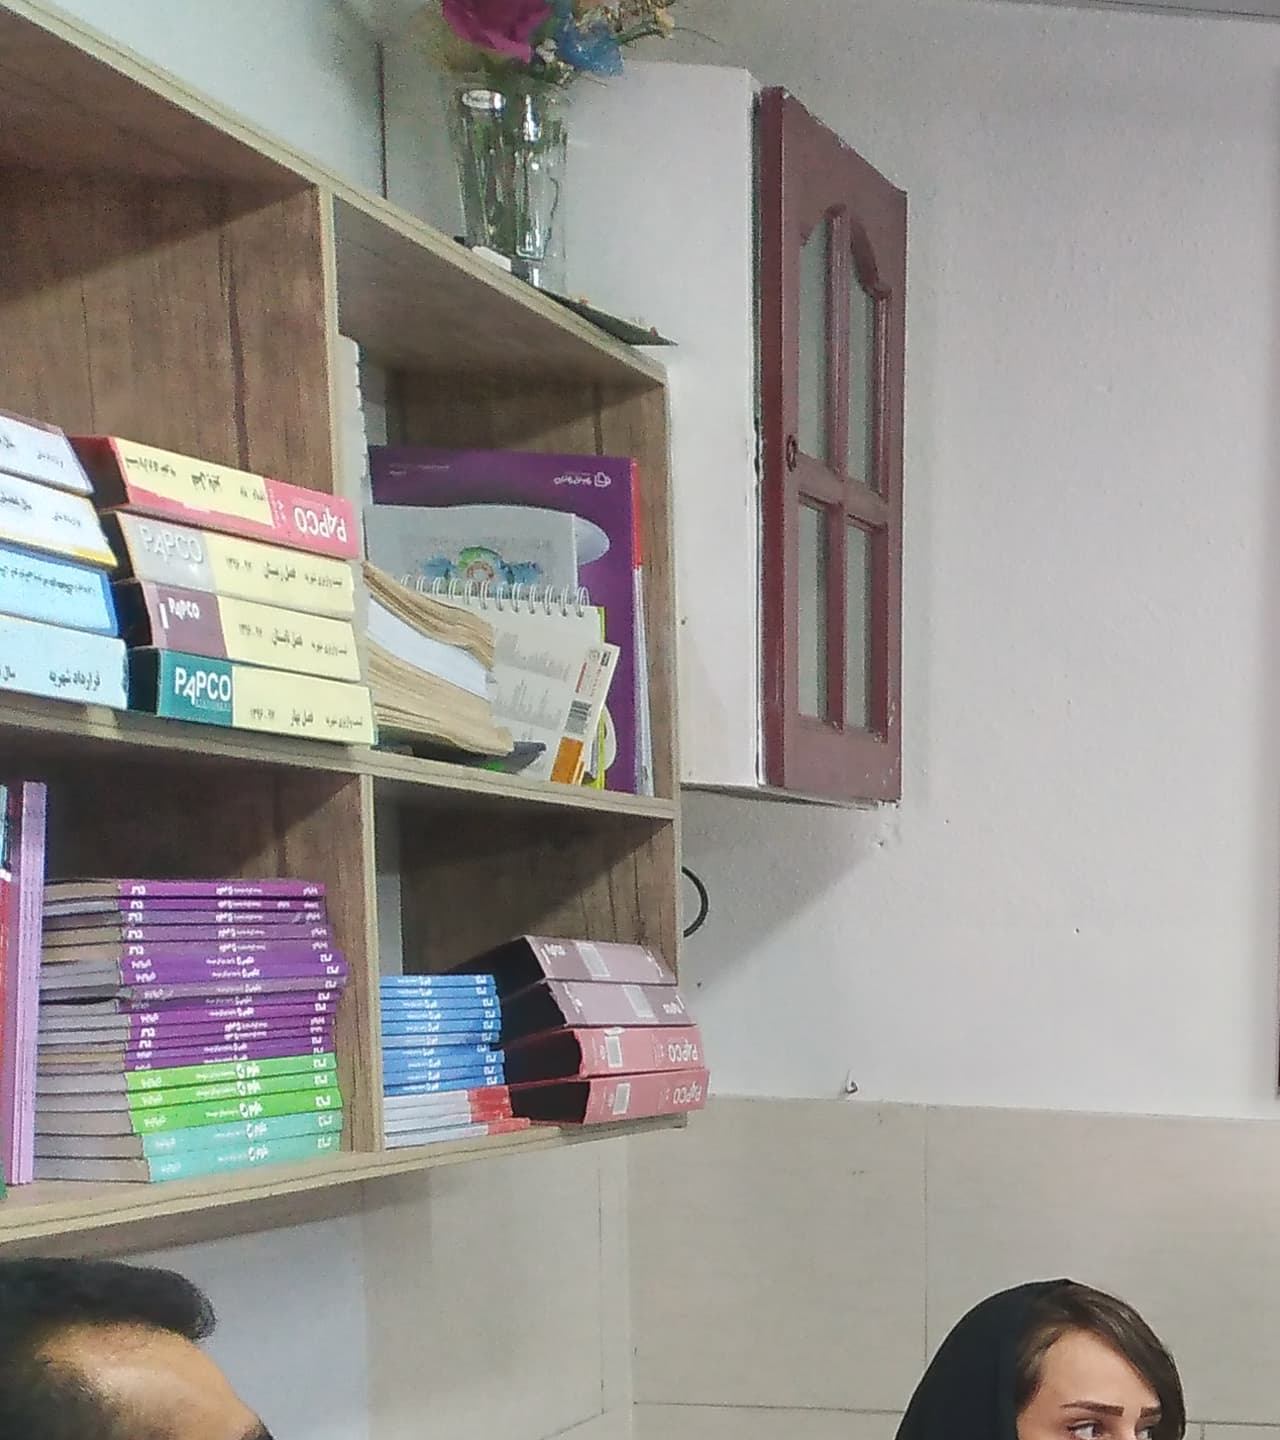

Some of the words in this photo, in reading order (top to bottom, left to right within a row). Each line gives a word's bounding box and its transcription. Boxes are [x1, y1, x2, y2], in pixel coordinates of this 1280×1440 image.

[294, 507, 347, 542] PAPCO
[140, 525, 204, 564] PAPCO
[168, 597, 200, 620] PAPCO
[174, 666, 231, 705] PAPCO
[668, 1040, 699, 1063] PAPCO
